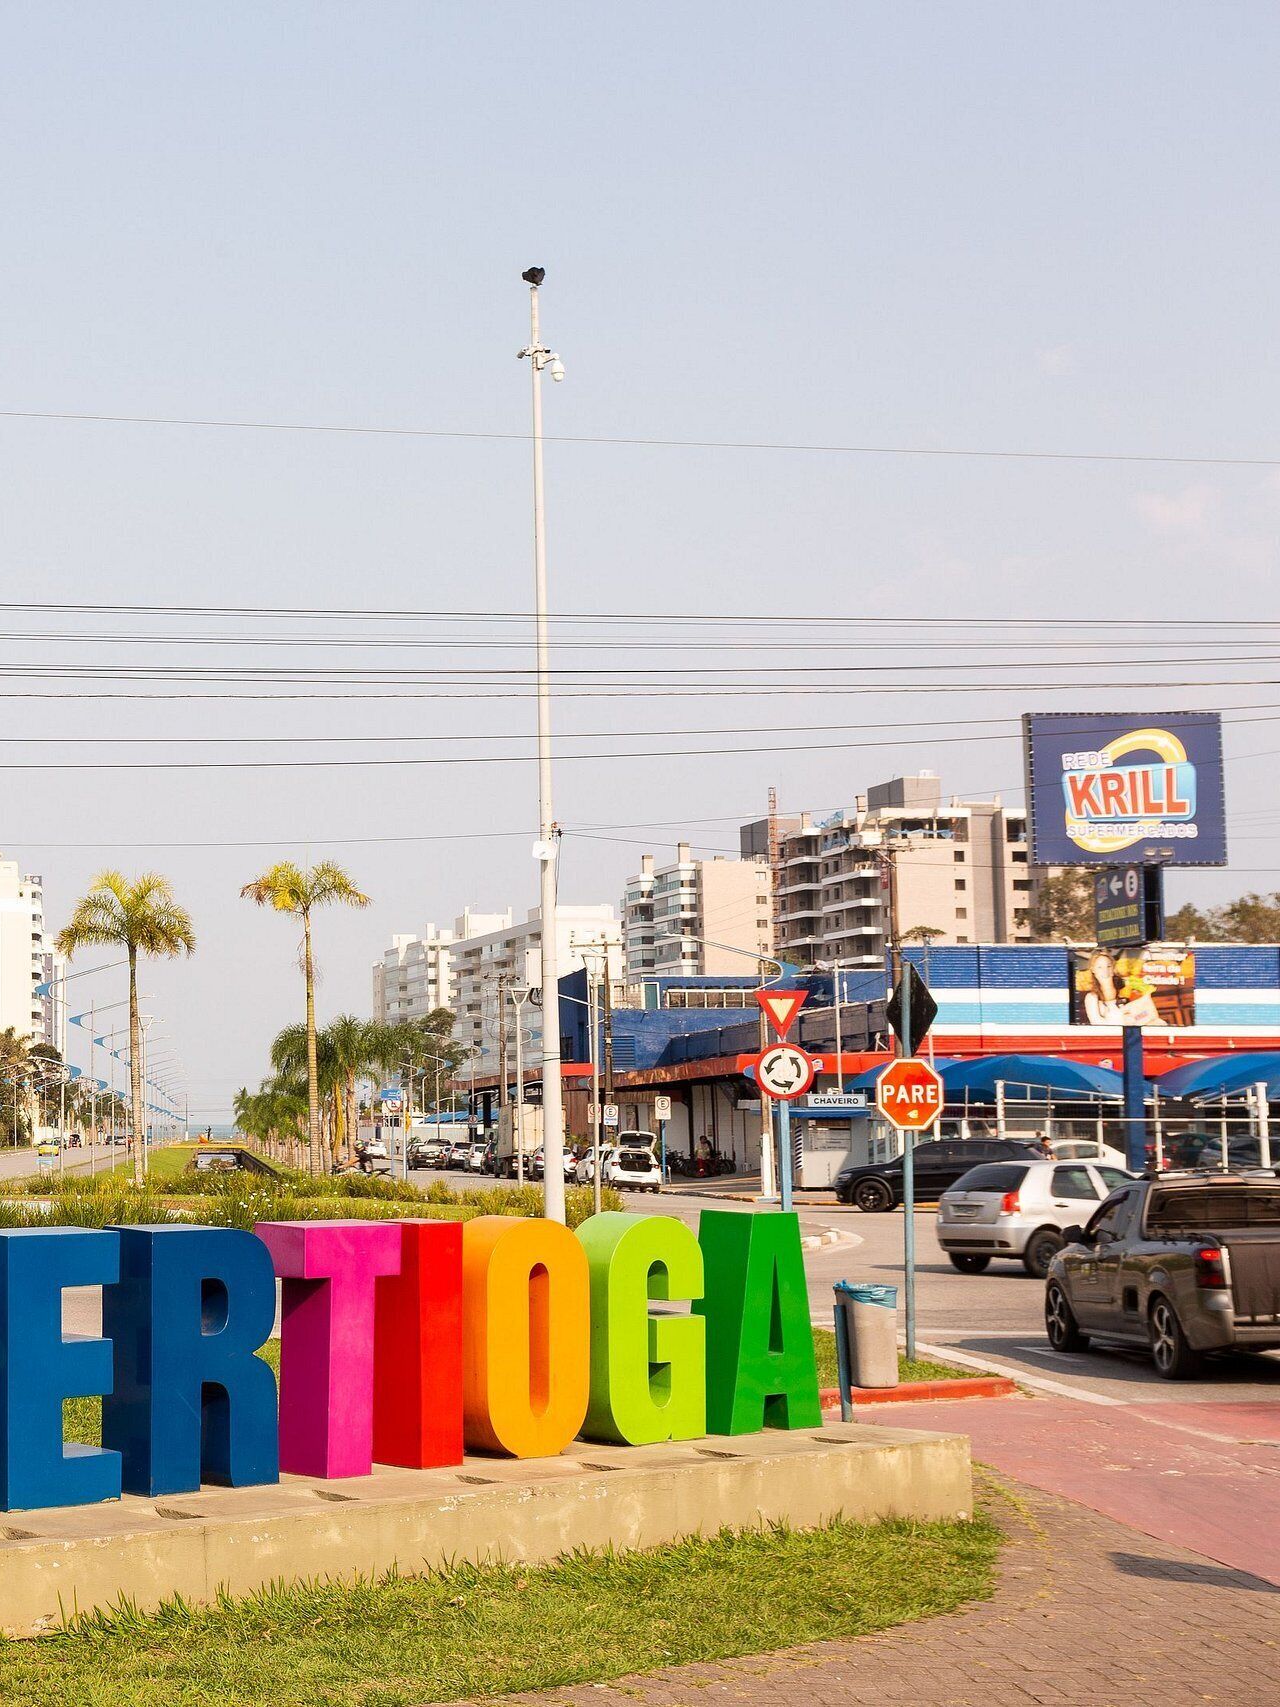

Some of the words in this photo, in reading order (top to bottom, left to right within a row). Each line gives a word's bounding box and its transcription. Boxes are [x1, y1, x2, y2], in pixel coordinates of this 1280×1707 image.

[1062, 751, 1113, 770] REDE
[1068, 767, 1188, 817] KRILL
[1066, 824, 1198, 838] SUPERMERCADOS
[813, 1097, 859, 1105] CHAVEIRO
[882, 1084, 938, 1104] PARE
[660, 1100, 667, 1108] E
